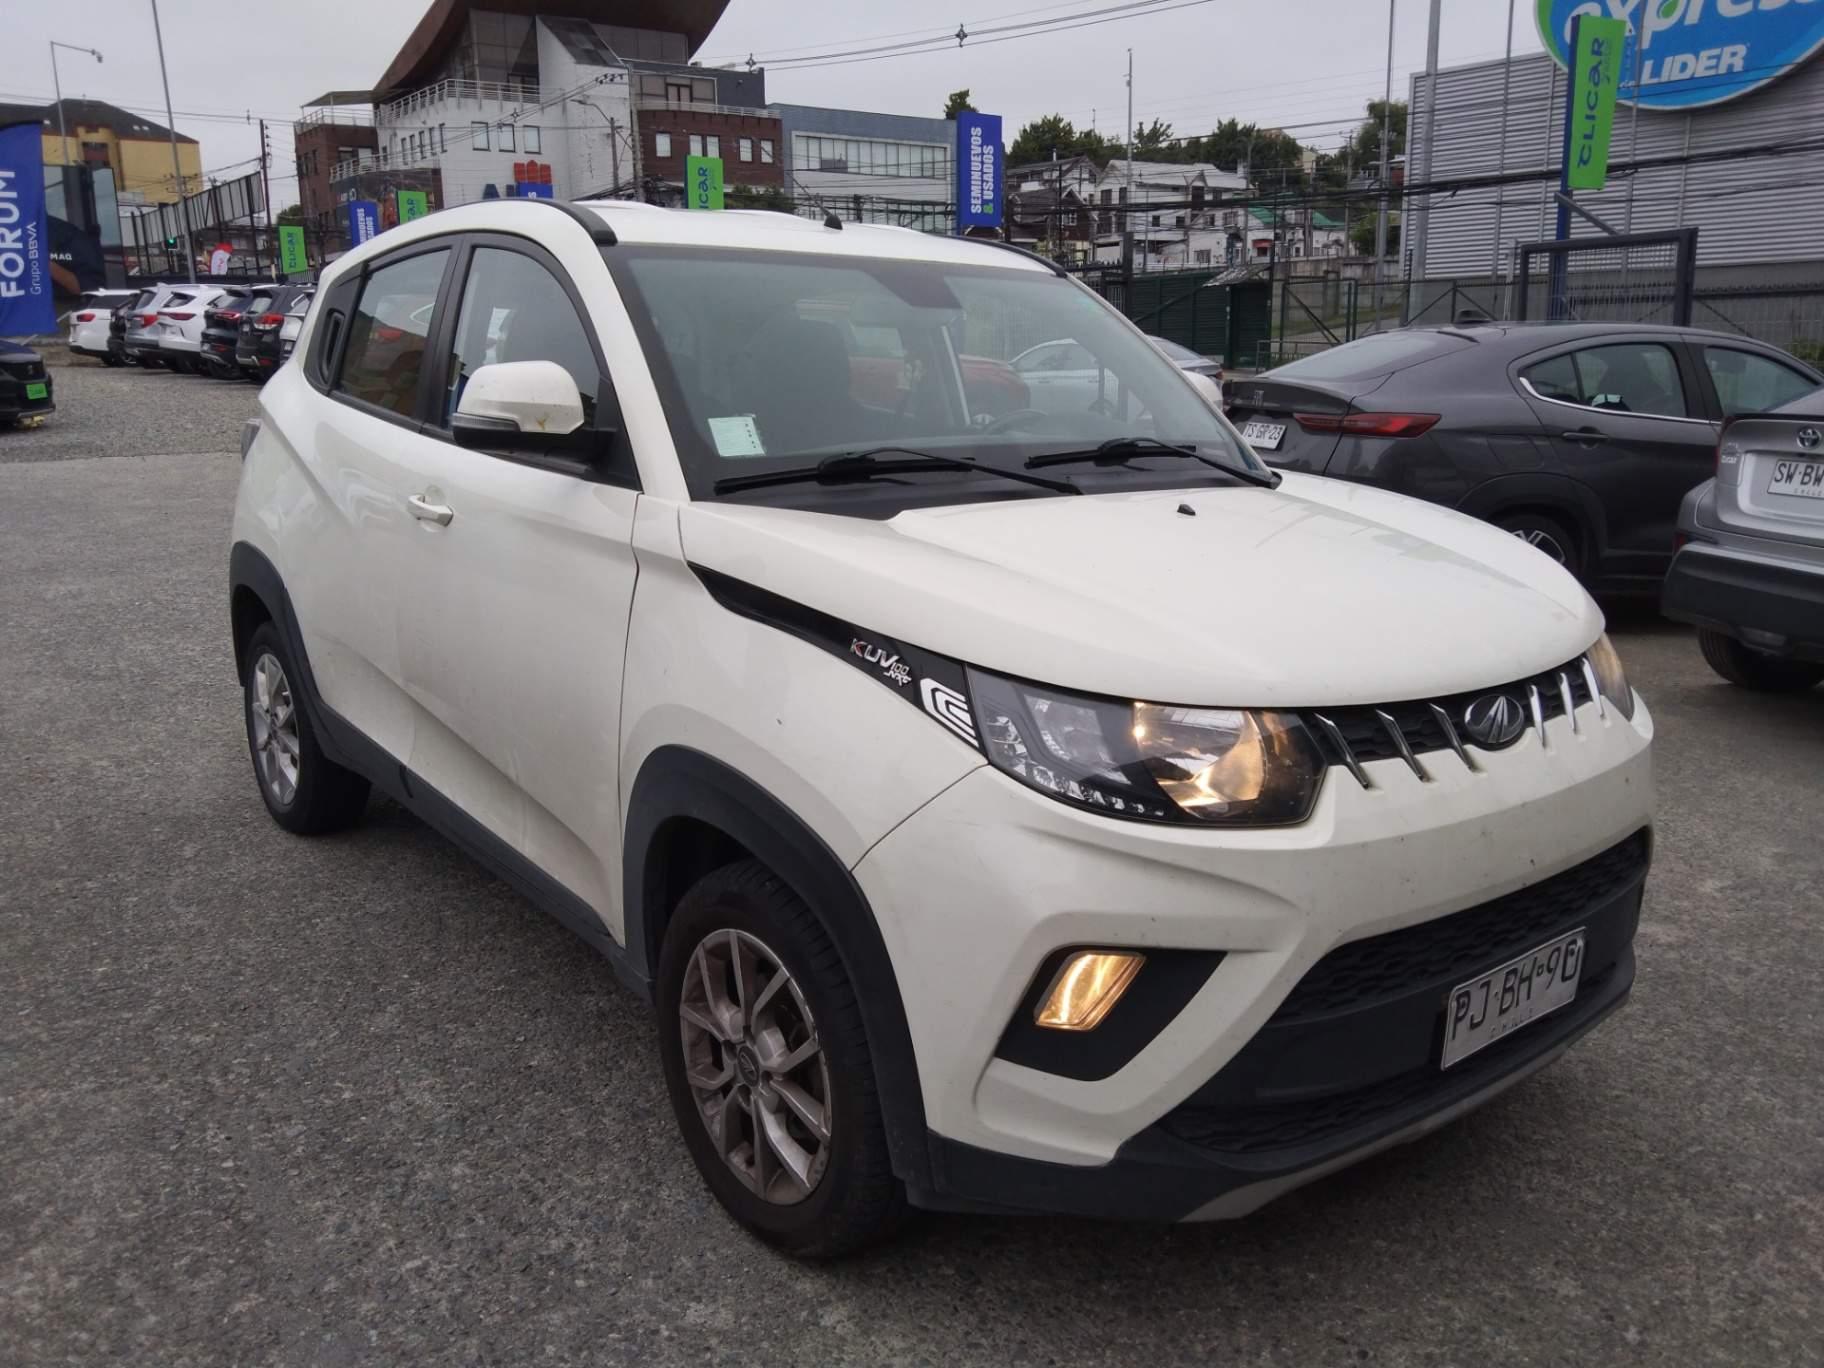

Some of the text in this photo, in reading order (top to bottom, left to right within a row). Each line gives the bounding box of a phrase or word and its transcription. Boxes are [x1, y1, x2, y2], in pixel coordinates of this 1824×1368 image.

[1640, 44, 1747, 86] LIDER
[971, 127, 982, 214] SEMINUEVOS
[983, 145, 994, 214] & USADOS
[0, 171, 25, 298] FORUM
[26, 221, 42, 295] Grupo BBVA
